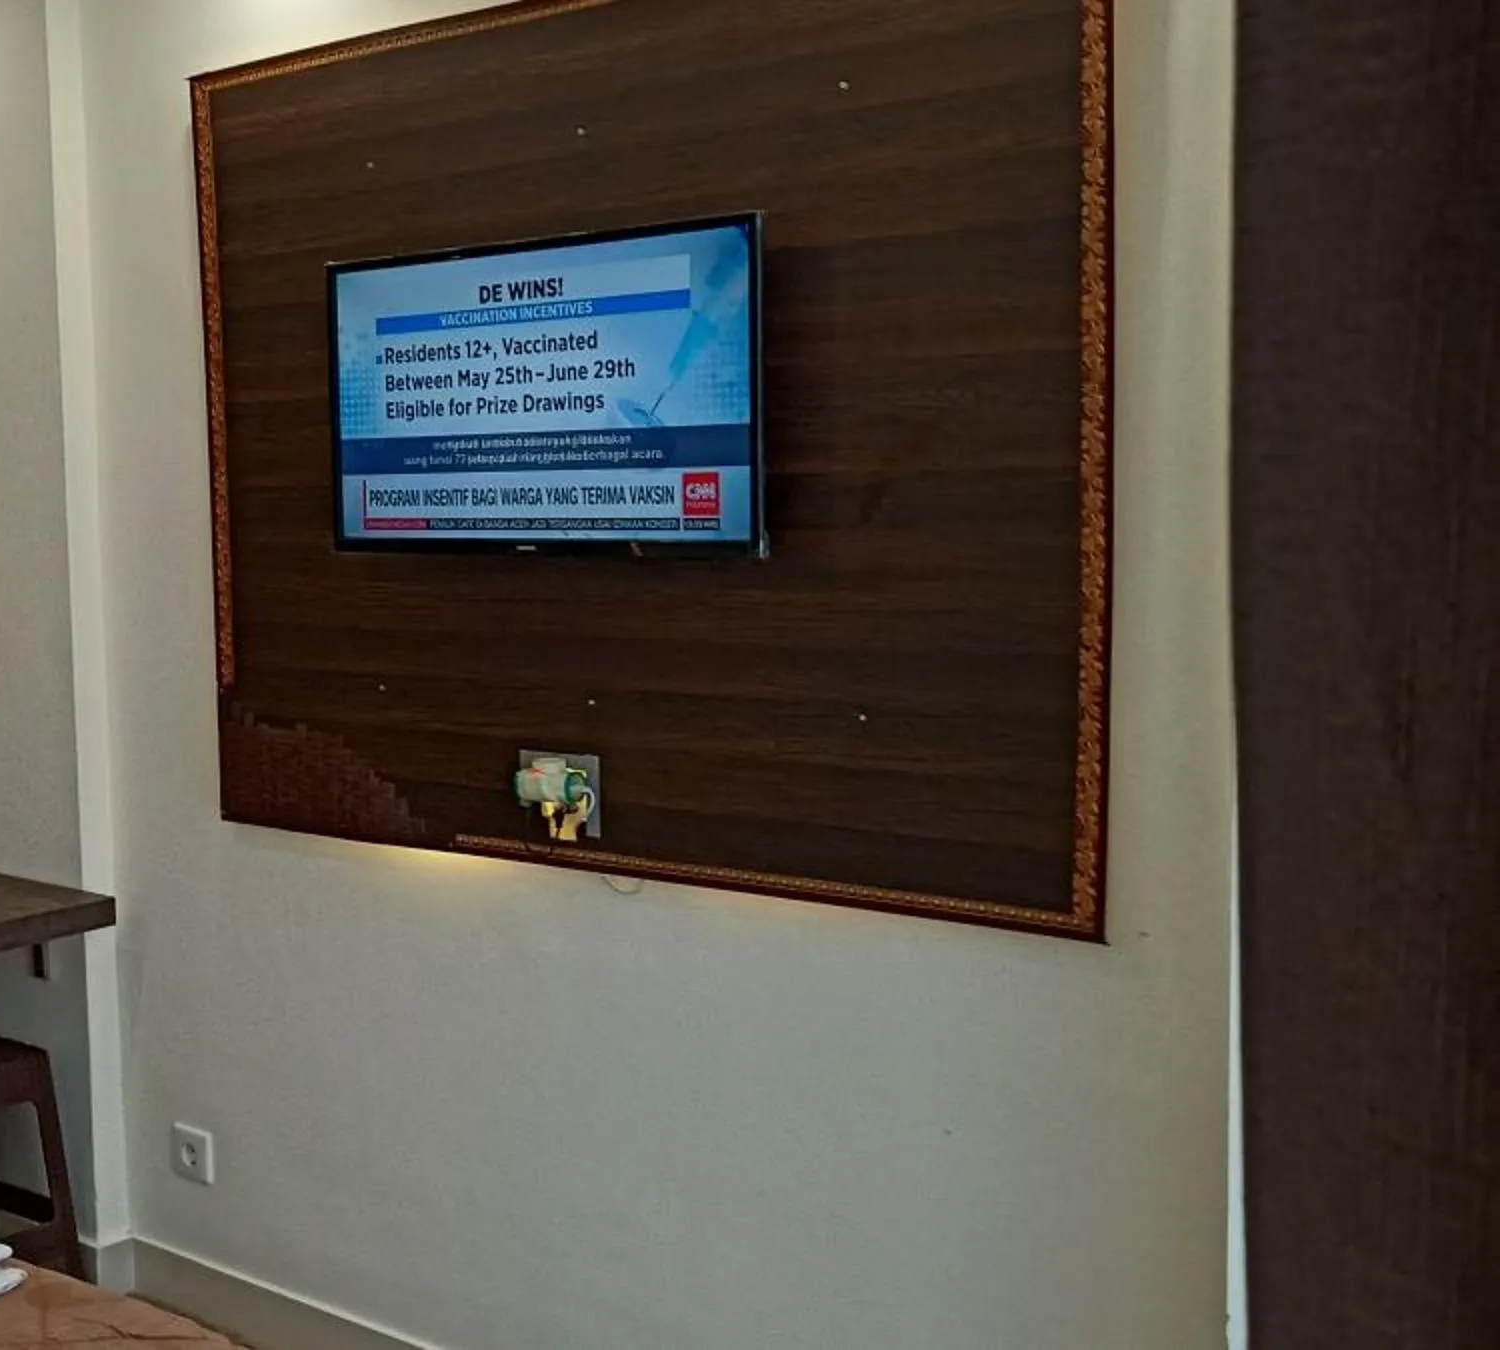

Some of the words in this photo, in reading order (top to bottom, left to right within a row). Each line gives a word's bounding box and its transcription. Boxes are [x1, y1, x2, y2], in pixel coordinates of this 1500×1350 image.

[479, 284, 503, 304] DE
[507, 277, 564, 301] WINS!
[439, 308, 517, 327] VACCINATION
[519, 301, 594, 320] INCENTIVES
[384, 343, 461, 365] Residents
[465, 339, 498, 361] 12+,
[502, 329, 598, 356] Vaccinated
[385, 374, 453, 393] Between
[457, 369, 491, 390] May
[593, 357, 636, 379] 29th
[386, 399, 445, 421] Eligible
[449, 397, 473, 417] for
[476, 395, 518, 416] Prize
[523, 391, 606, 414] Drawings
[369, 488, 421, 507] PROGRAM
[422, 488, 469, 507] INSENTIF
[471, 487, 499, 506] BAGI
[501, 487, 543, 506] WARGA
[544, 486, 579, 506] YANG
[580, 486, 627, 505] TERIMA
[628, 485, 675, 505] VAKSIN
